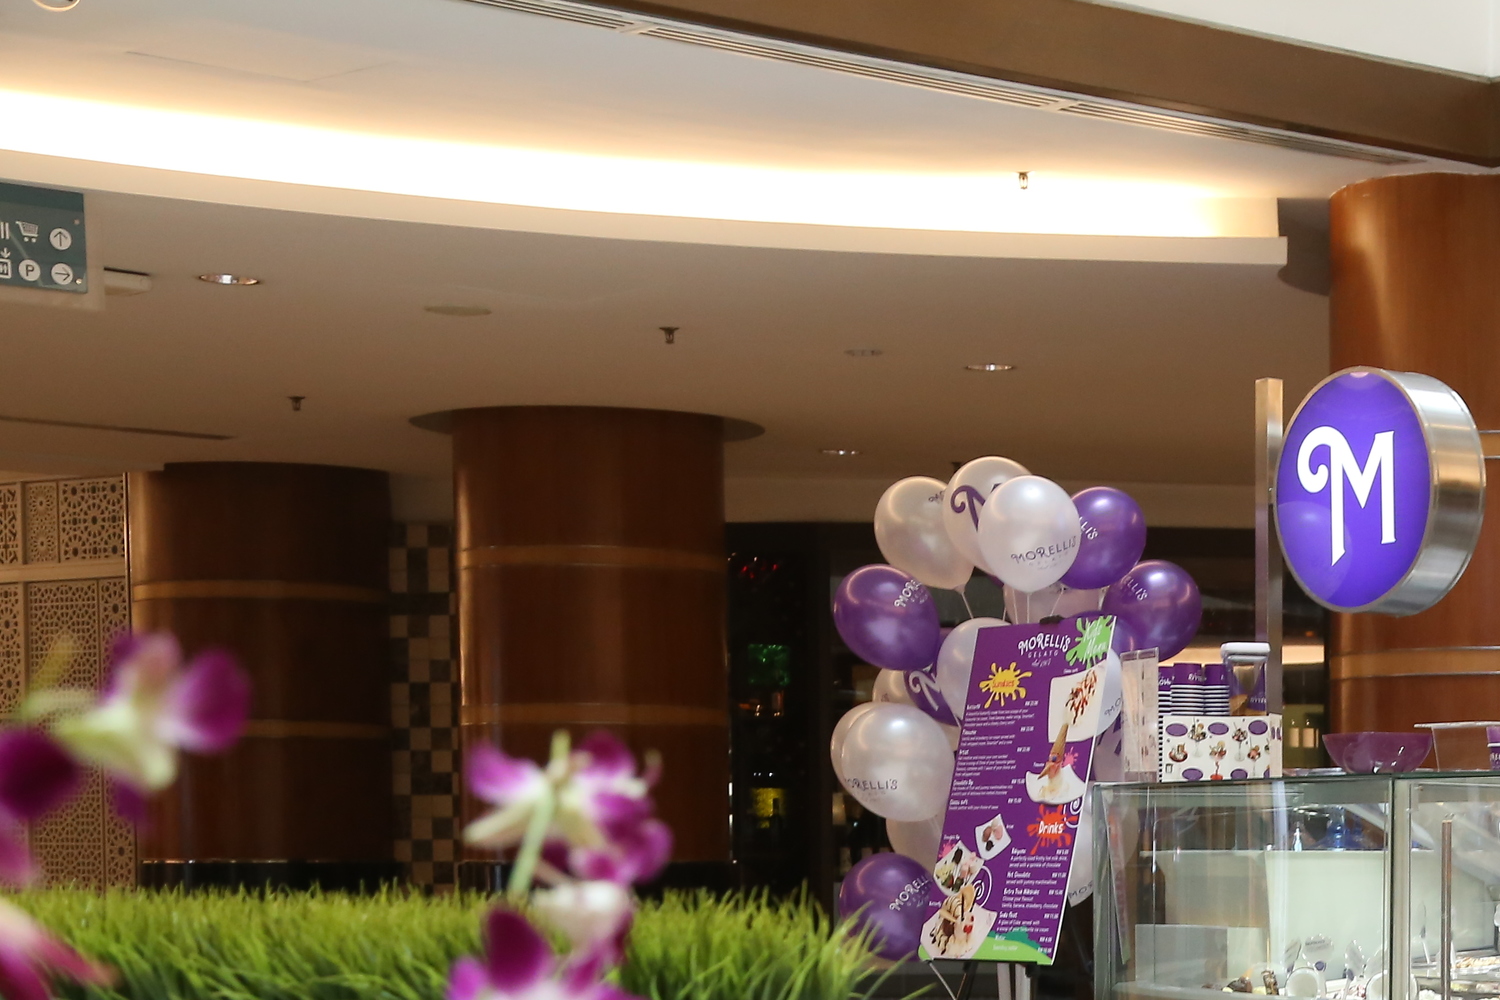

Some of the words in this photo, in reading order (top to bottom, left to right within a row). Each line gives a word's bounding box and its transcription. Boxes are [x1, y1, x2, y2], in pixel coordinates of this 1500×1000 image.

[1297, 425, 1397, 567] M
[1018, 632, 1071, 656] MORELLI'S
[1039, 821, 1064, 835] Drinks
